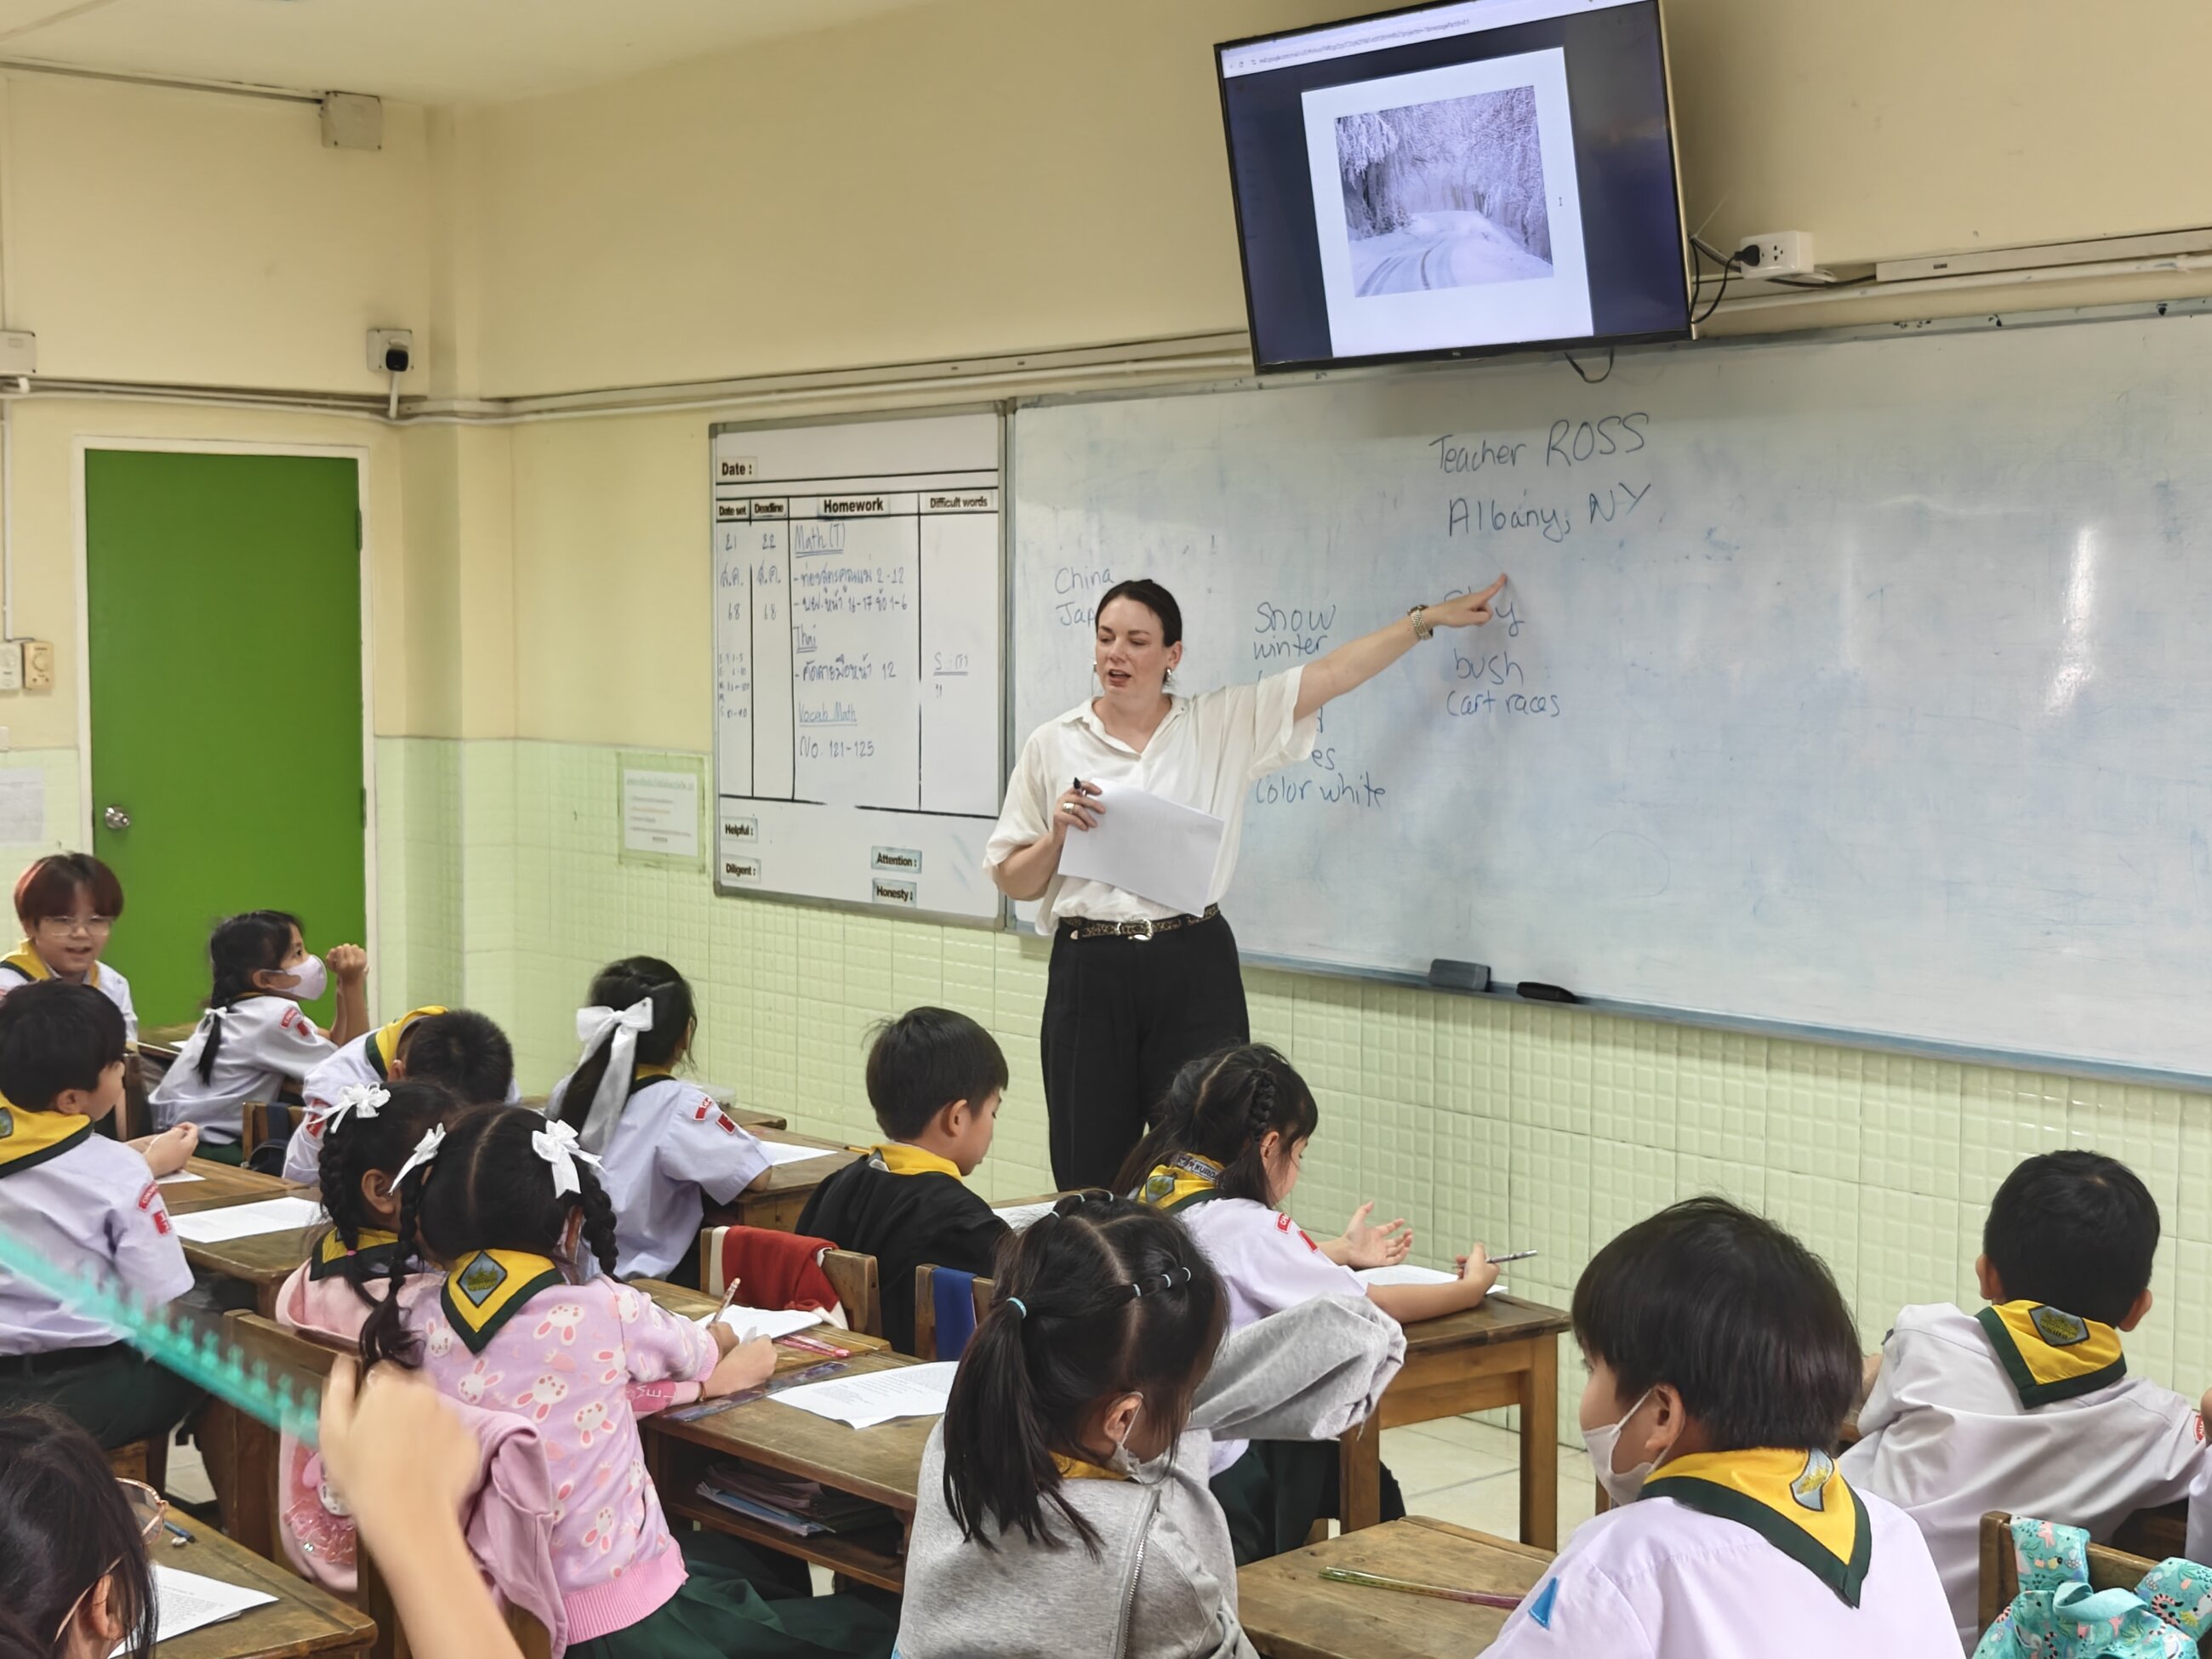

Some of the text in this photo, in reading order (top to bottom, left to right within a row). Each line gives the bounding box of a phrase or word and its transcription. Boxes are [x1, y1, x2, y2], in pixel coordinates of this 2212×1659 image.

[1429, 413, 1649, 473] Teacher ROSS
[755, 502, 784, 514] Deadline
[824, 498, 884, 513] Homework
[930, 496, 988, 509] Difficult words
[1589, 482, 1651, 524] NY
[795, 524, 827, 551] Math
[1055, 567, 1115, 595] China
[1056, 601, 1096, 628] Jap
[793, 624, 817, 647] Thai
[1254, 634, 1328, 659] winter
[1320, 771, 1385, 807] white
